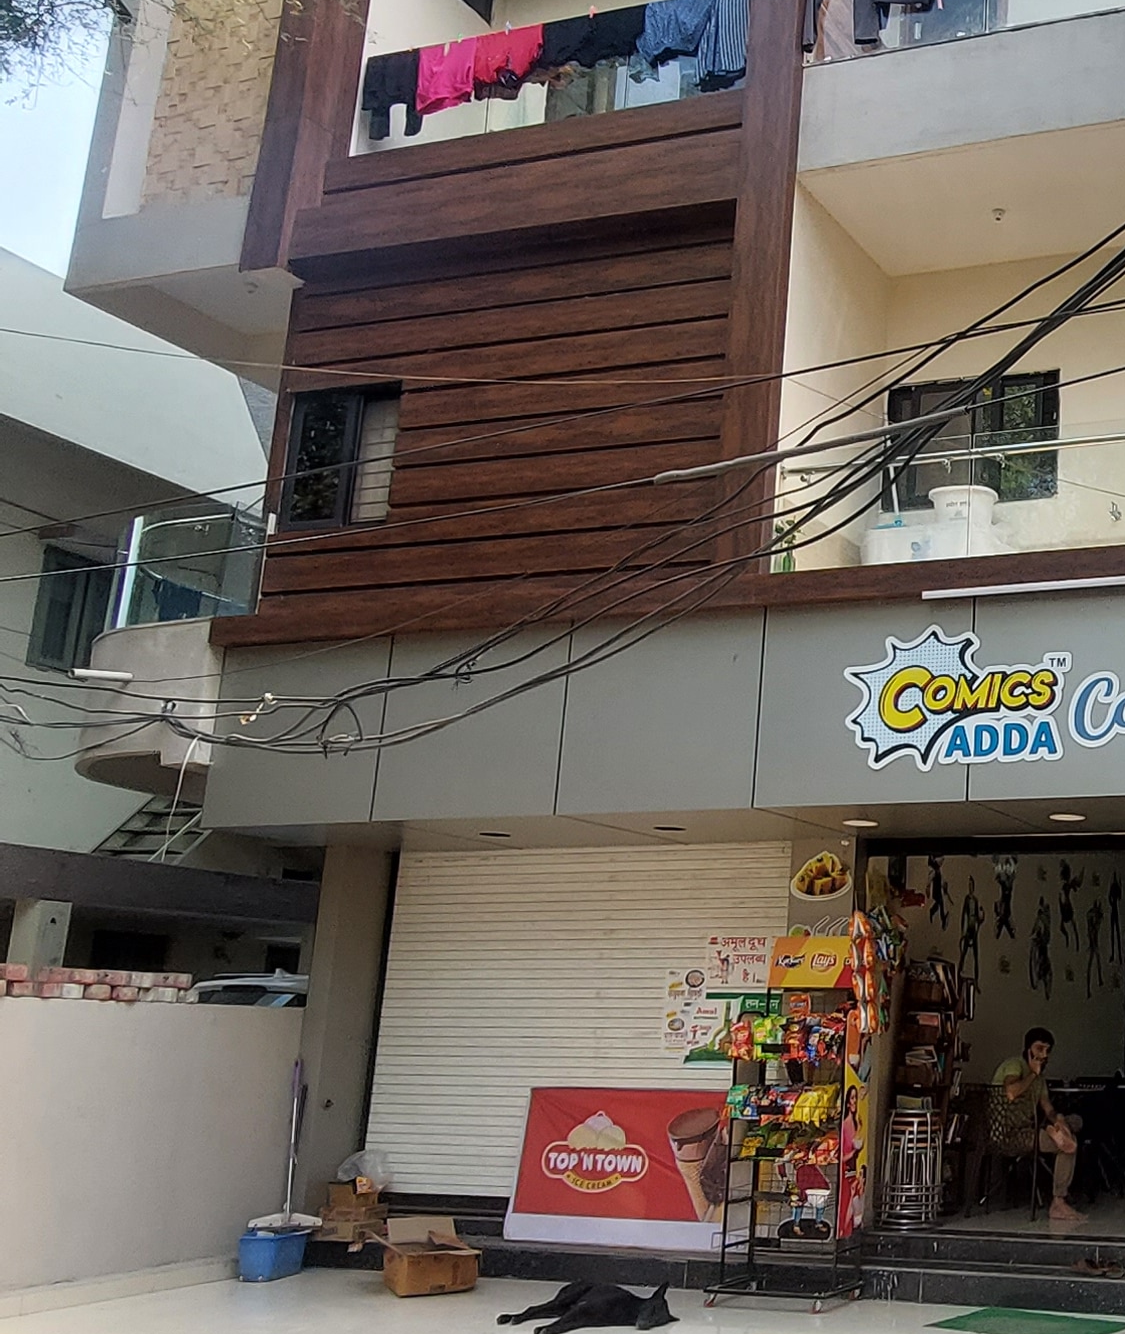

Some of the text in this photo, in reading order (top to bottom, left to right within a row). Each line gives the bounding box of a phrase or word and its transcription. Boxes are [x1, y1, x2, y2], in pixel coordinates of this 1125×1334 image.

[879, 666, 1057, 732] COMICS
[945, 721, 1057, 759] ADDA
[548, 1153, 579, 1170] TOP
[595, 1154, 643, 1173] TOWN
